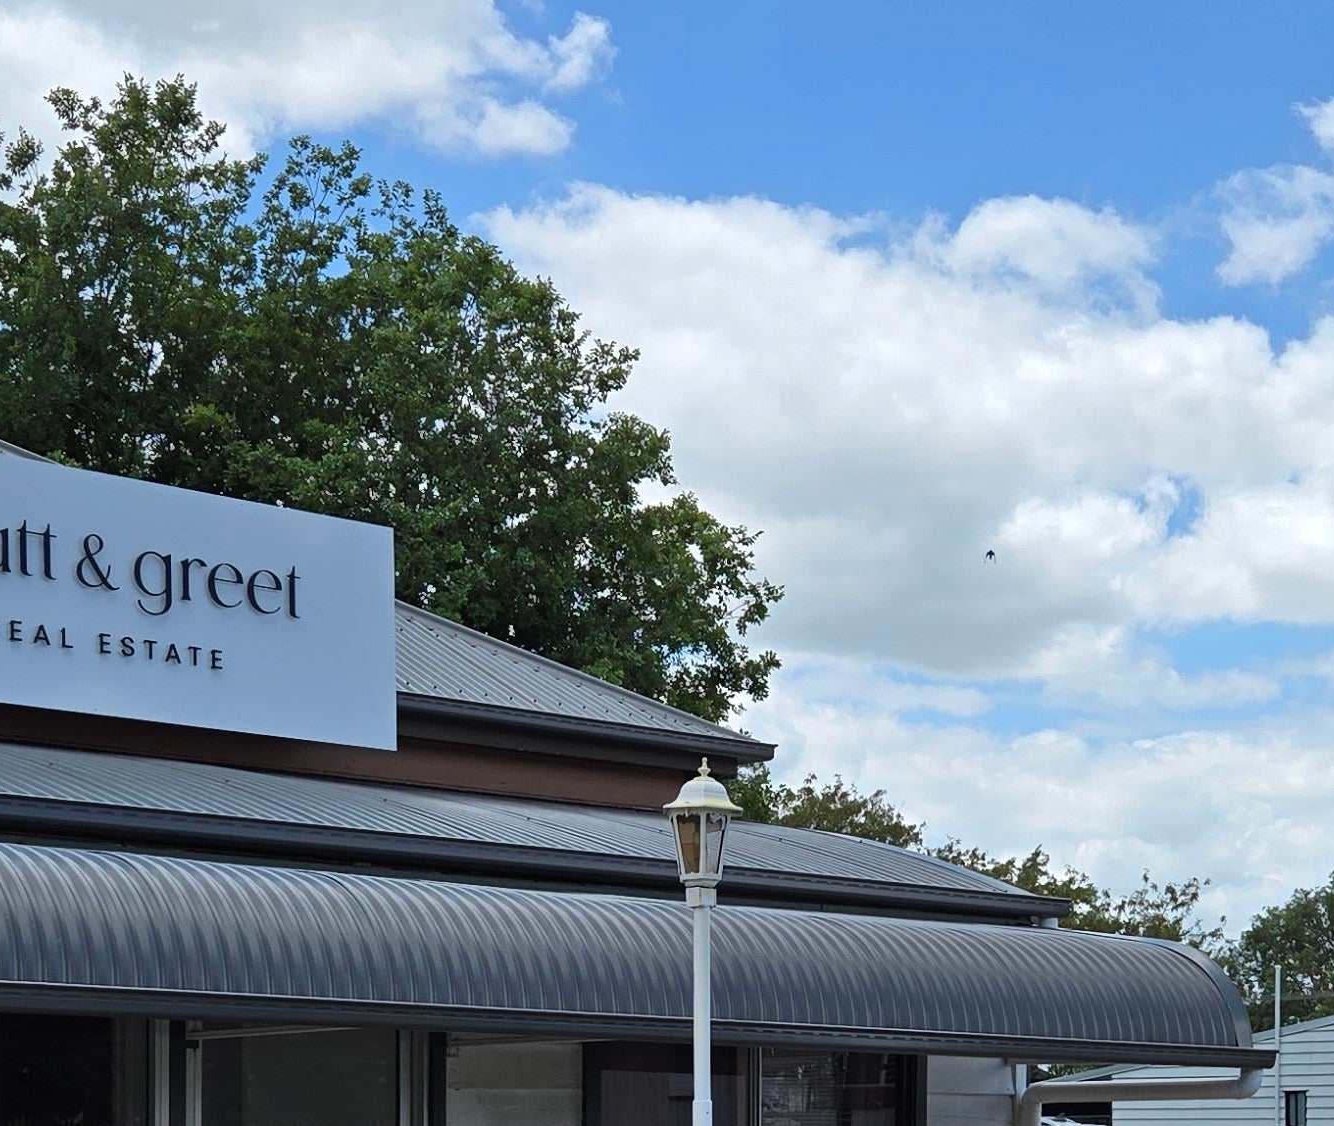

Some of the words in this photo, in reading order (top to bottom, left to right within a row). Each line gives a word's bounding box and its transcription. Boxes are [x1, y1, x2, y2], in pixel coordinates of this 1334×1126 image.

[75, 533, 121, 591] &
[133, 550, 302, 619] greet
[98, 632, 225, 671] ESTATE
